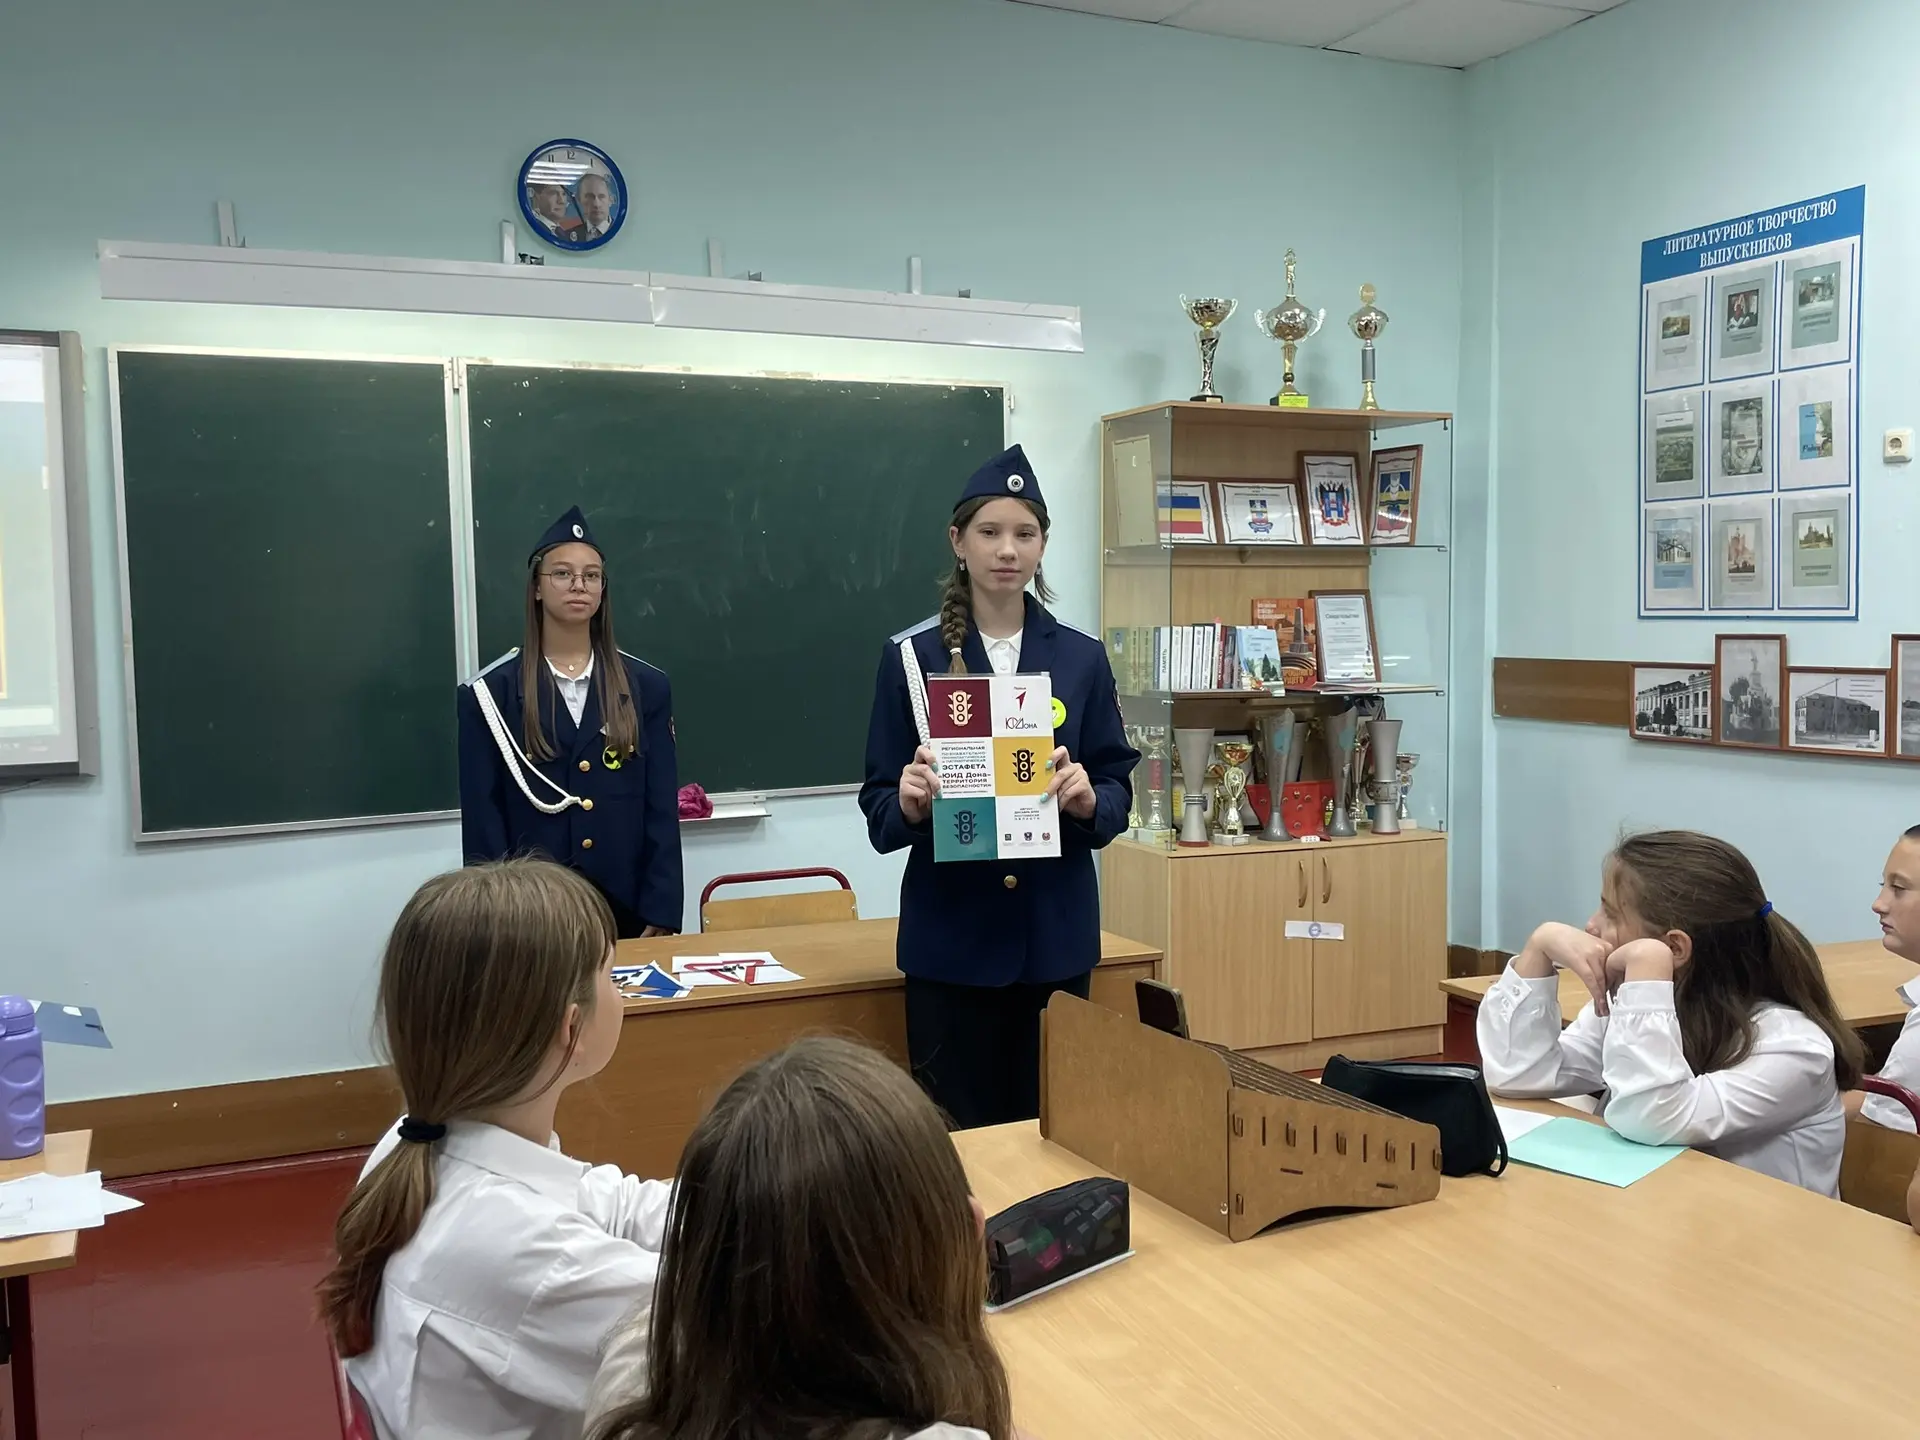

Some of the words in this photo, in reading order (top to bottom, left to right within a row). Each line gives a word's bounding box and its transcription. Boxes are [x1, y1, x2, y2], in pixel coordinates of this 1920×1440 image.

[566, 149, 576, 160] 12
[1663, 219, 1754, 255] ЛИТЕРАТУРНОЕ
[1757, 199, 1837, 230] ТВОРЧЕСТВО
[1699, 233, 1792, 268] ВЫПУСКНИКОВ
[942, 763, 987, 771] ЭСТАФЕТА
